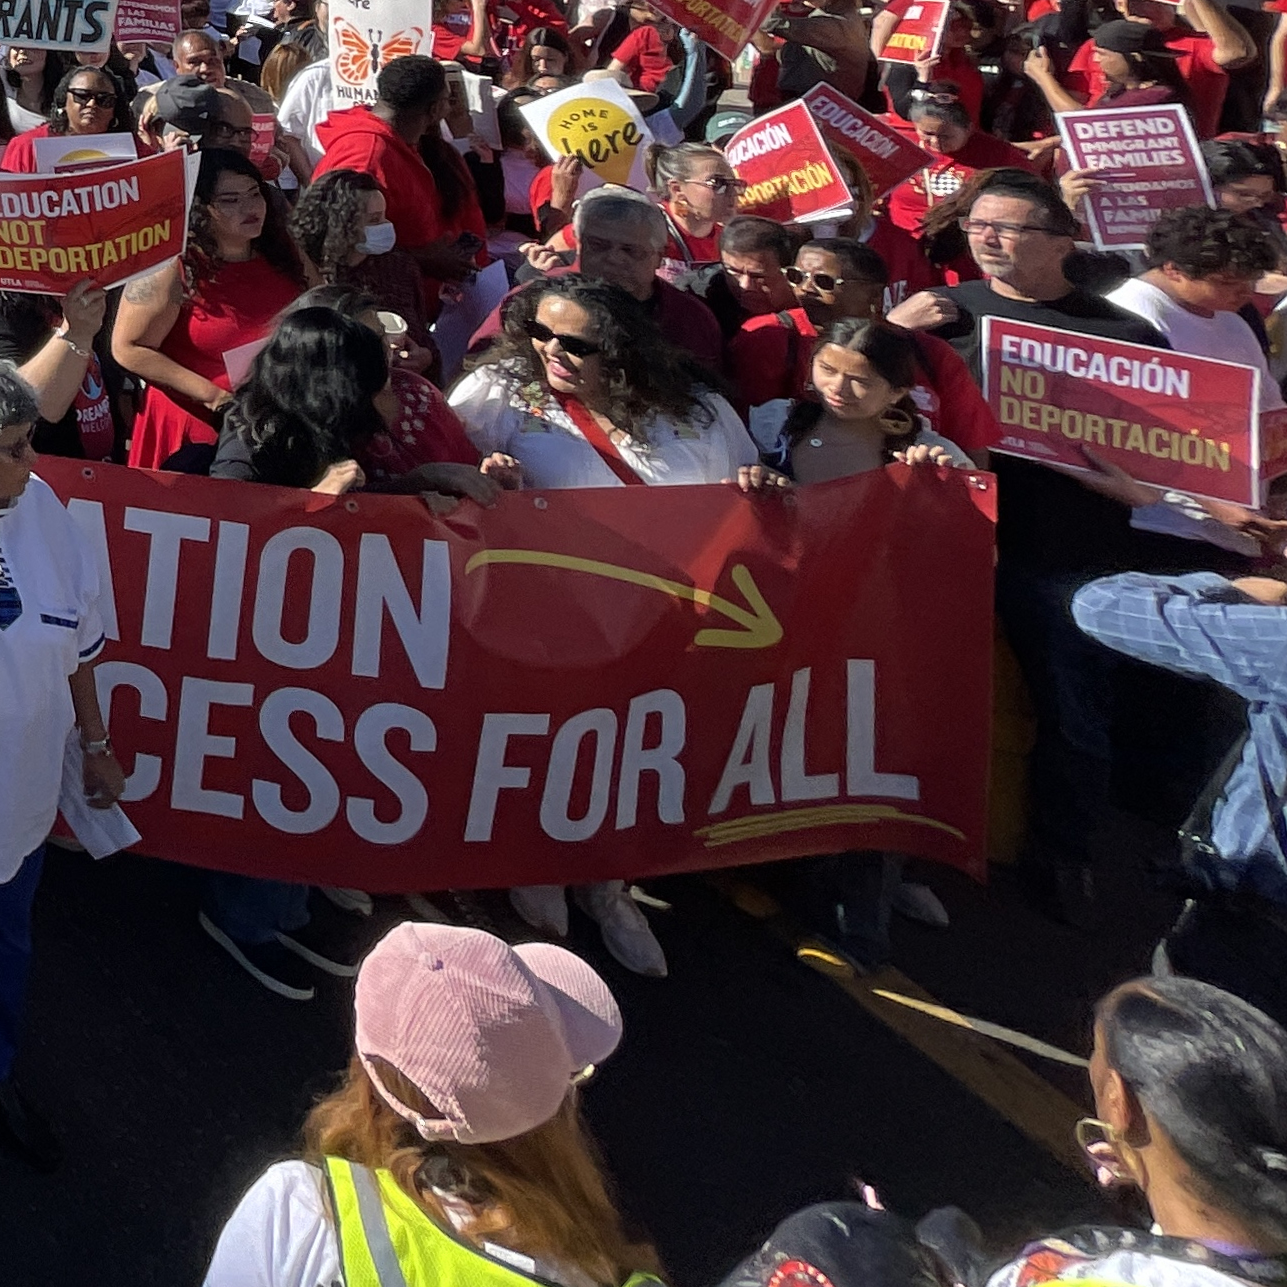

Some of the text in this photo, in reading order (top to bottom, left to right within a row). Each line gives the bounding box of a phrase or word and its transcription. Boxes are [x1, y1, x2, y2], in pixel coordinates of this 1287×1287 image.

[117, 17, 176, 32] FAMILIAS
[559, 108, 609, 130] HOME
[581, 122, 599, 133] IS
[809, 95, 901, 159] EDUCACIÓN
[1073, 117, 1175, 139] DEFEND
[560, 121, 645, 170] here
[728, 121, 793, 167] DUCACIÓN
[1080, 136, 1181, 153] IMMIGRANT
[1084, 149, 1186, 170] FAMILIES
[738, 160, 834, 208] PORTACIÓN
[1100, 195, 1149, 207] A LAS
[1102, 208, 1162, 223] FAMI
[1001, 334, 1190, 399] EDUCACIÓN
[1001, 365, 1045, 400] NO
[1000, 394, 1231, 473] DEPORTACIÓN
[94, 658, 920, 845] CESS FOR ALL
